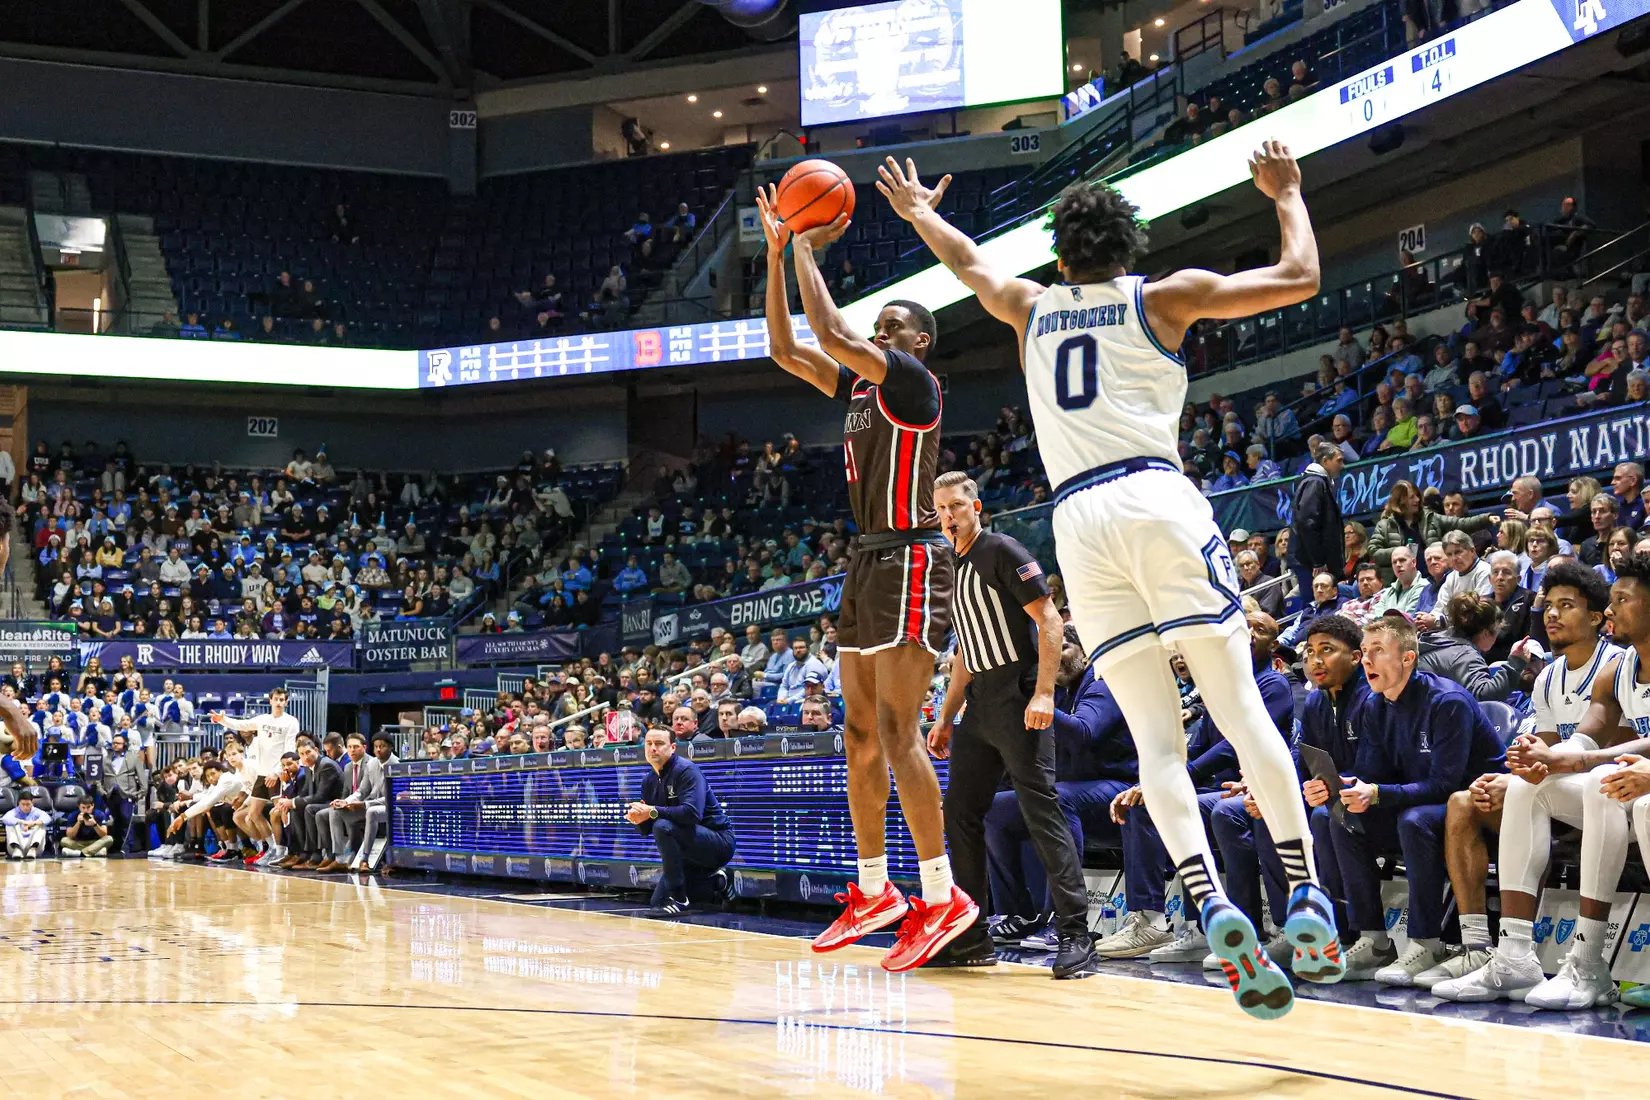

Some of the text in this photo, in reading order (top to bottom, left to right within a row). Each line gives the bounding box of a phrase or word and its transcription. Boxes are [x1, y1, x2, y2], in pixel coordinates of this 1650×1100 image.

[1420, 46, 1453, 70] T.O.L.
[1348, 70, 1387, 101] FOULS
[1431, 68, 1442, 93] 4
[450, 112, 476, 127] 302
[1363, 99, 1373, 122] 0
[1011, 135, 1039, 152] 303
[1400, 227, 1424, 252] 204
[1037, 303, 1127, 338] MONTGOMERY
[1054, 333, 1098, 411] 0
[249, 418, 277, 436] 202
[1460, 433, 1557, 489] RHODY
[731, 595, 783, 625] BRING
[789, 591, 822, 614] THE
[42, 630, 71, 641] Rite
[368, 627, 446, 643] MATUNUCK
[24, 654, 42, 662] FIRE
[178, 645, 281, 664] THE RHODY WAY
[366, 646, 448, 662] OYSTER BAR
[90, 764, 99, 777] 3
